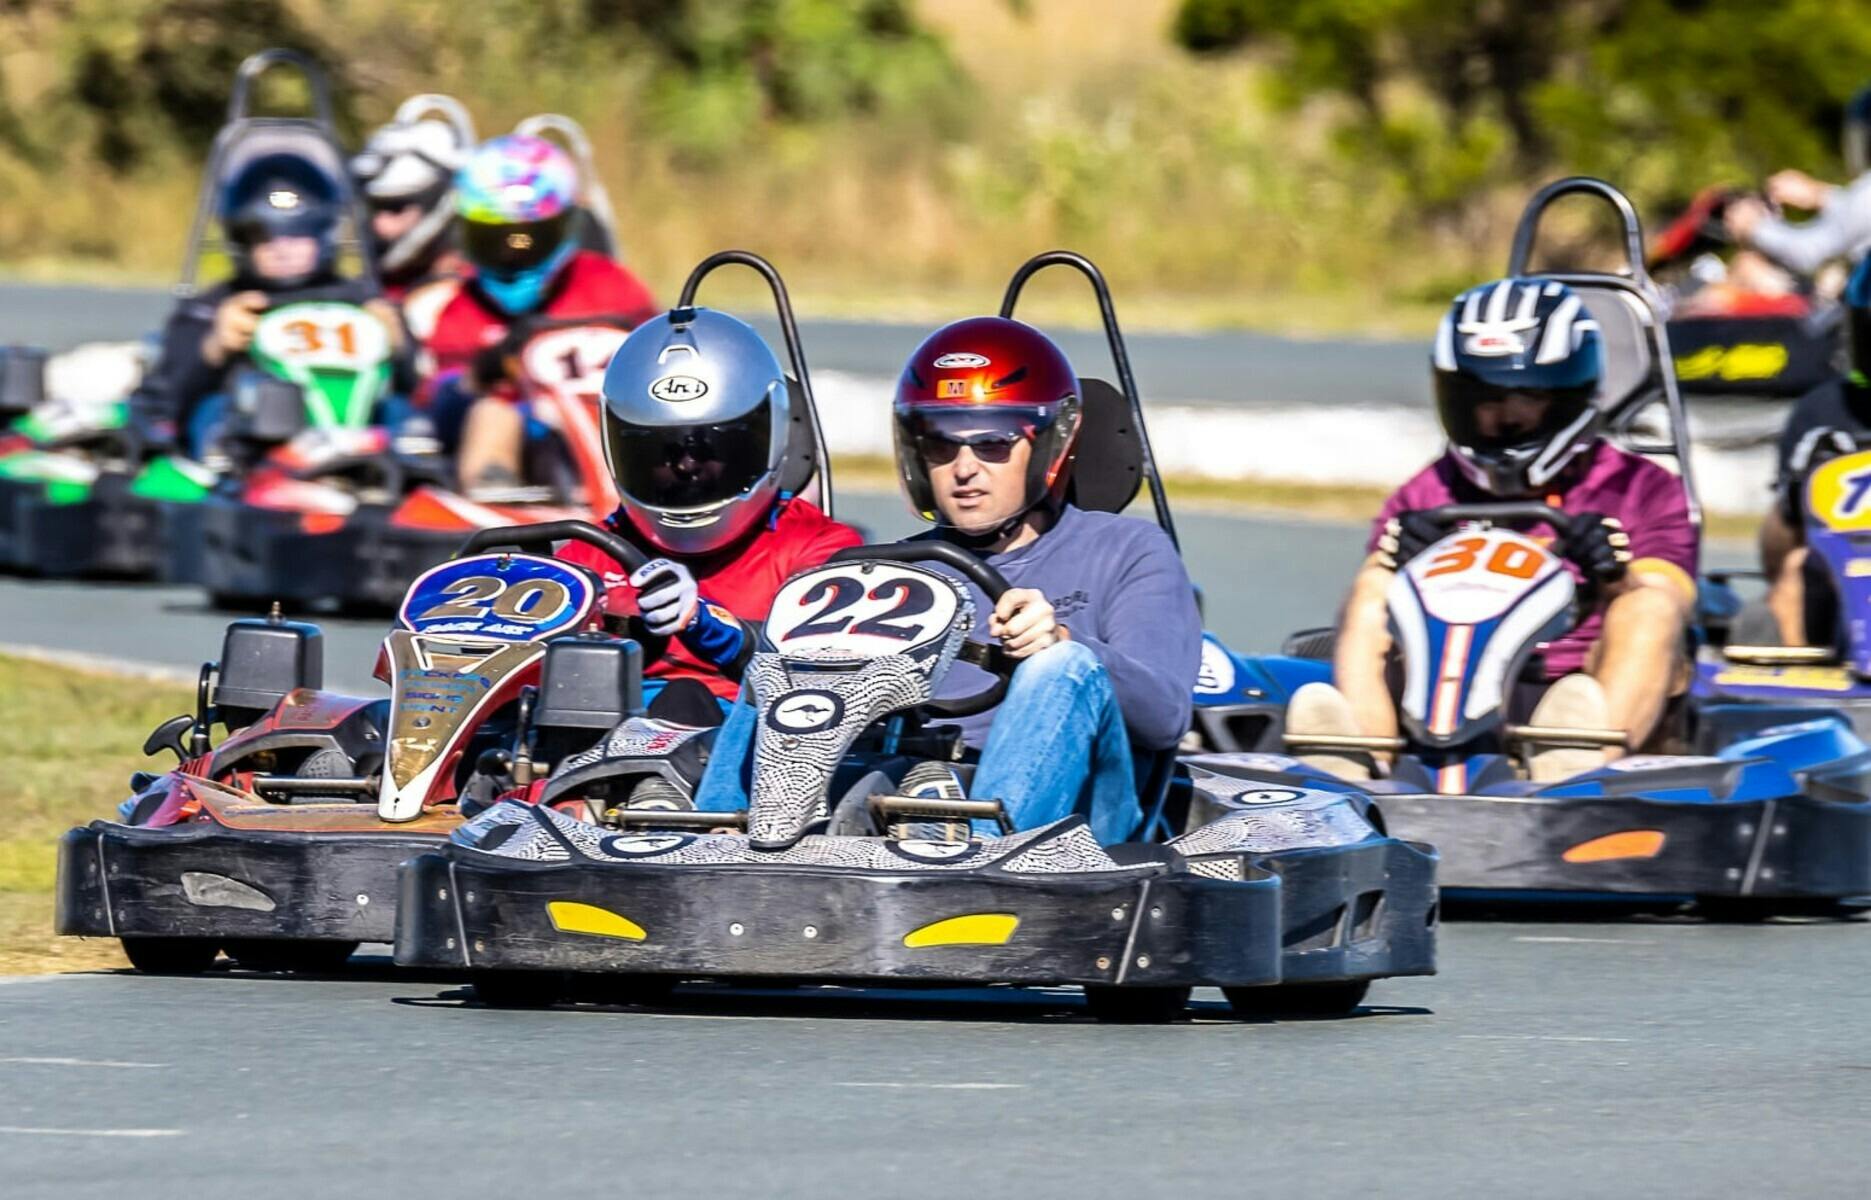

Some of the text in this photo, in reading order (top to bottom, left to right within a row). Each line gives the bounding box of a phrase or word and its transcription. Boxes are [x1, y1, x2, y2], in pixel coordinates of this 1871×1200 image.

[281, 320, 359, 355] 31
[1423, 537, 1547, 580] 30
[417, 575, 571, 625] 20
[781, 576, 935, 643] 22
